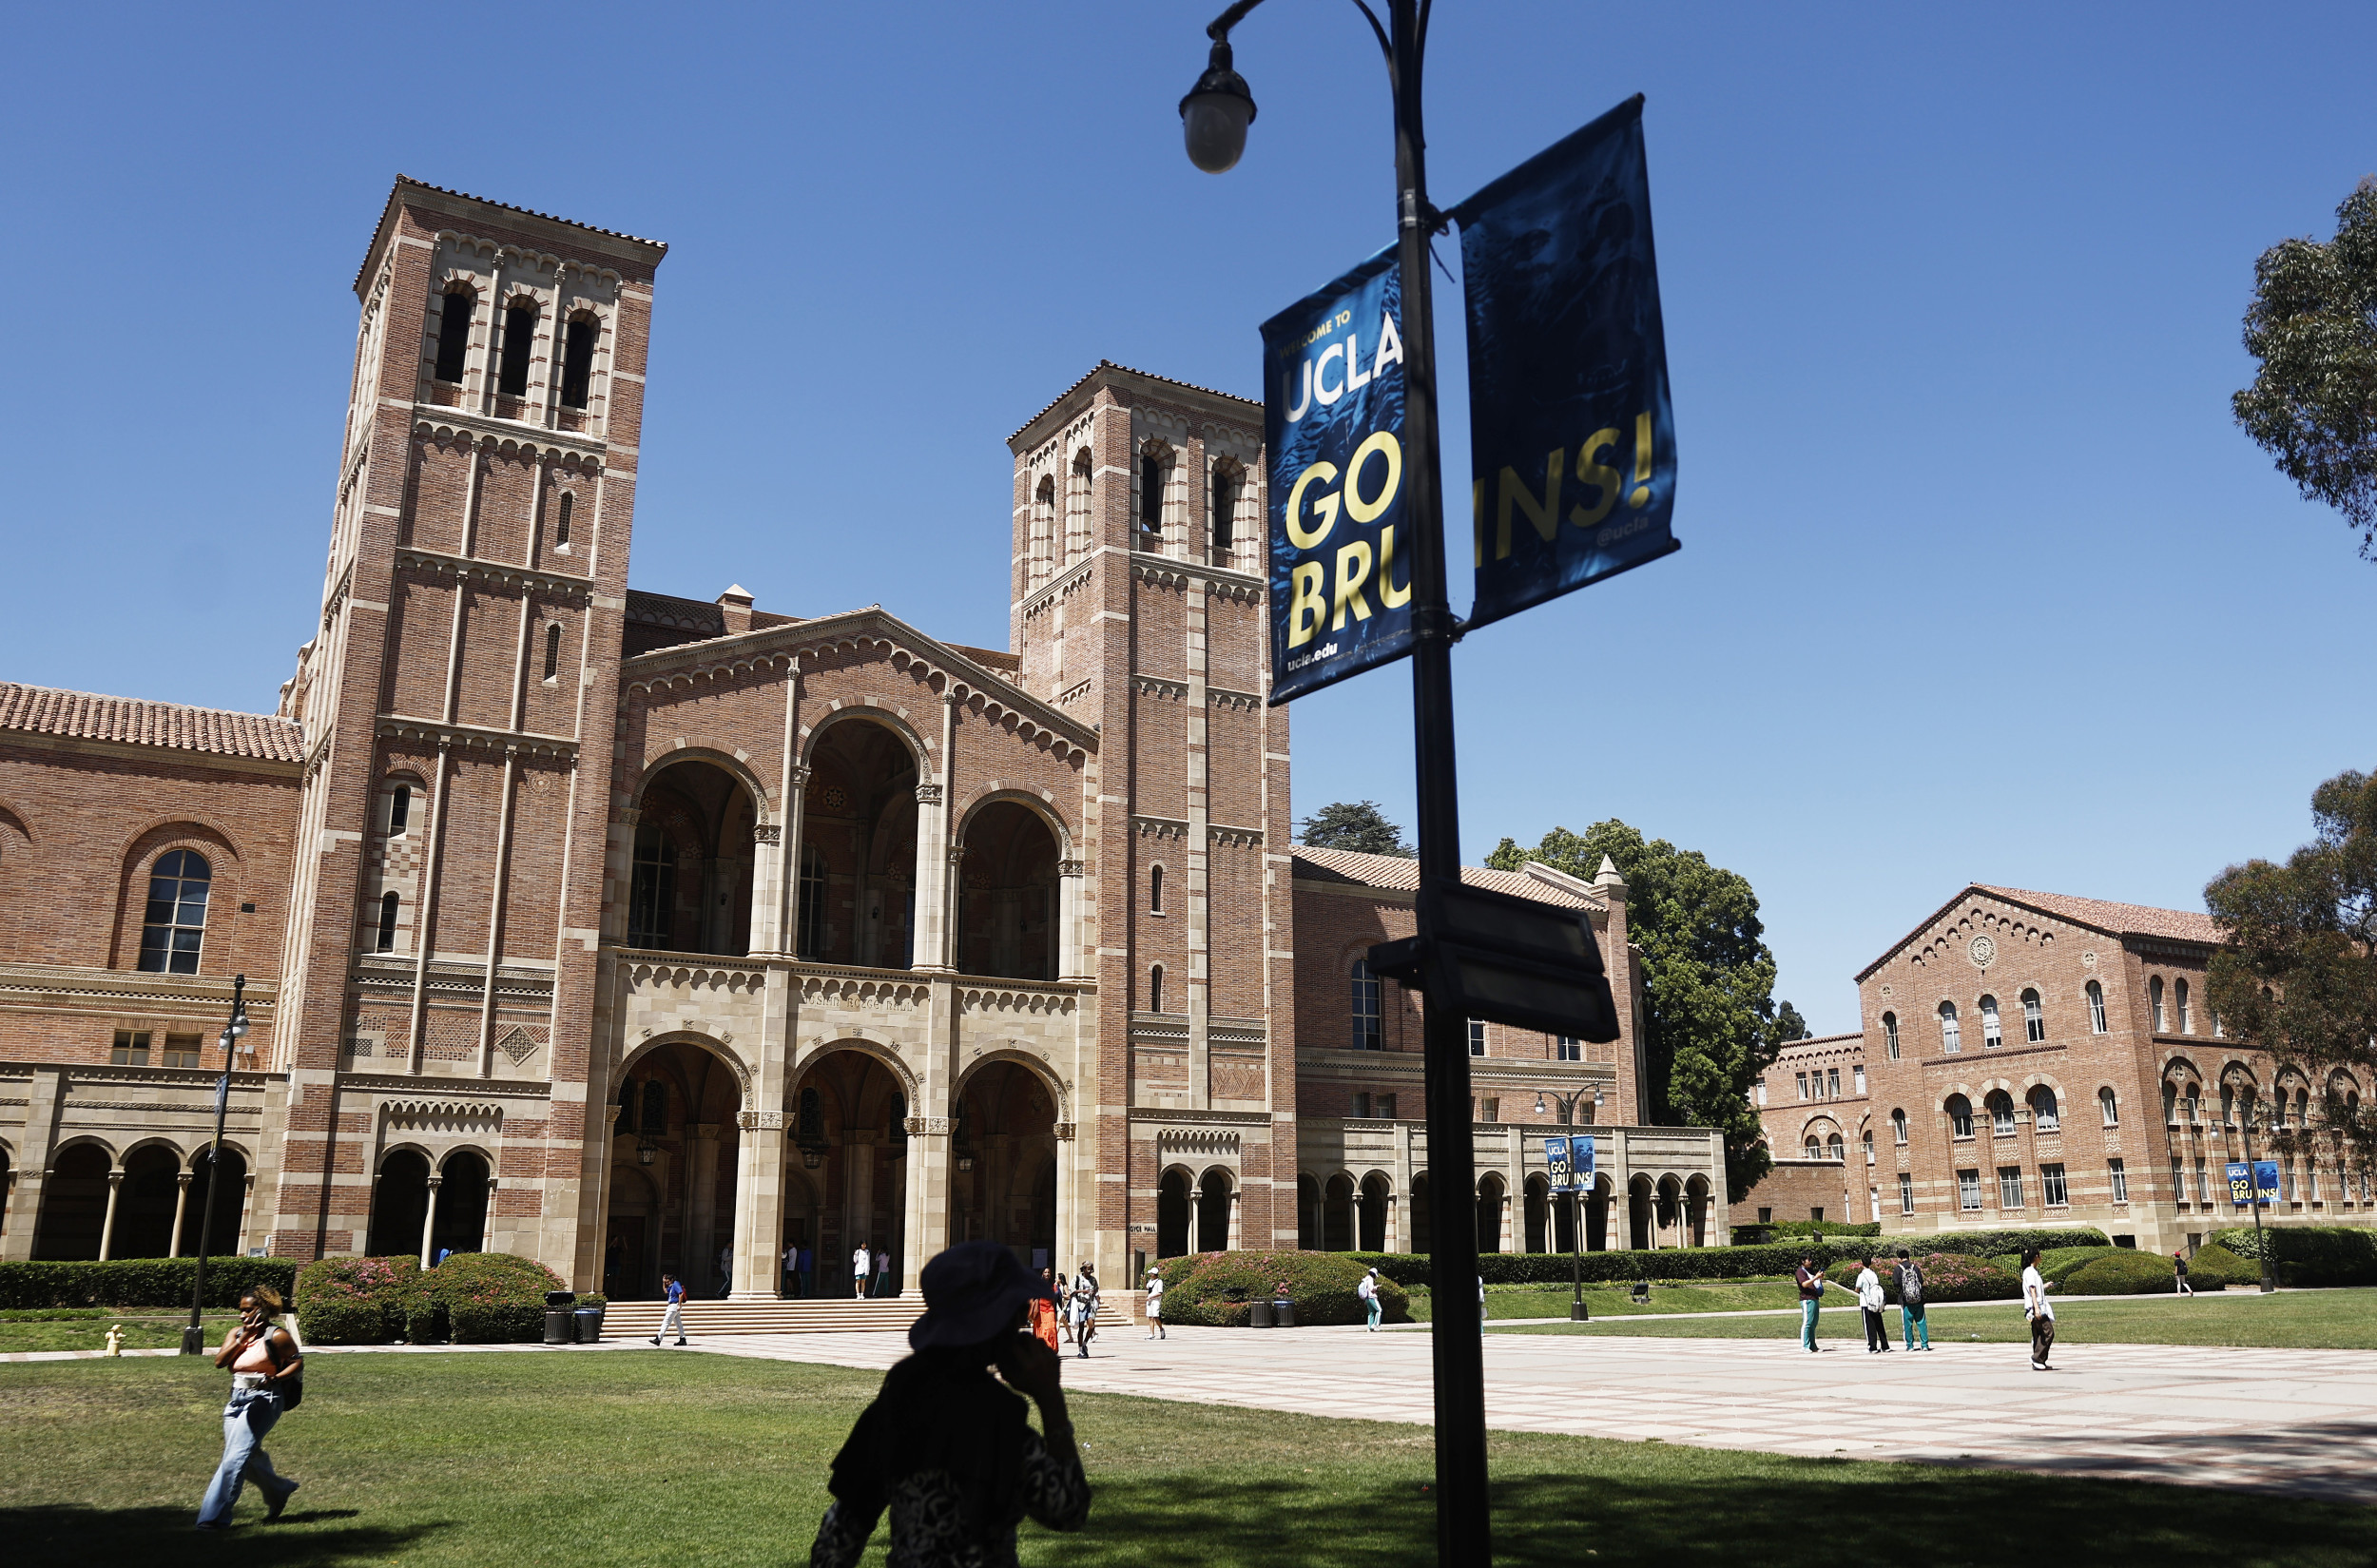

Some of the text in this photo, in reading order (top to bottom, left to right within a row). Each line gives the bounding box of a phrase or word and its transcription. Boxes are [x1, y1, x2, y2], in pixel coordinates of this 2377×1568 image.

[1280, 309, 1350, 358] WELCOME TO
[1283, 311, 1403, 423] UCLA
[1285, 431, 1402, 550] GO
[1596, 516, 1649, 547] @ucla
[1287, 642, 1338, 671] ucla.edu
[805, 995, 840, 1007] OSIAH
[1548, 1146, 1566, 1155] UCLA
[1551, 1161, 1567, 1173] GO
[2231, 1180, 2249, 1190] GO
